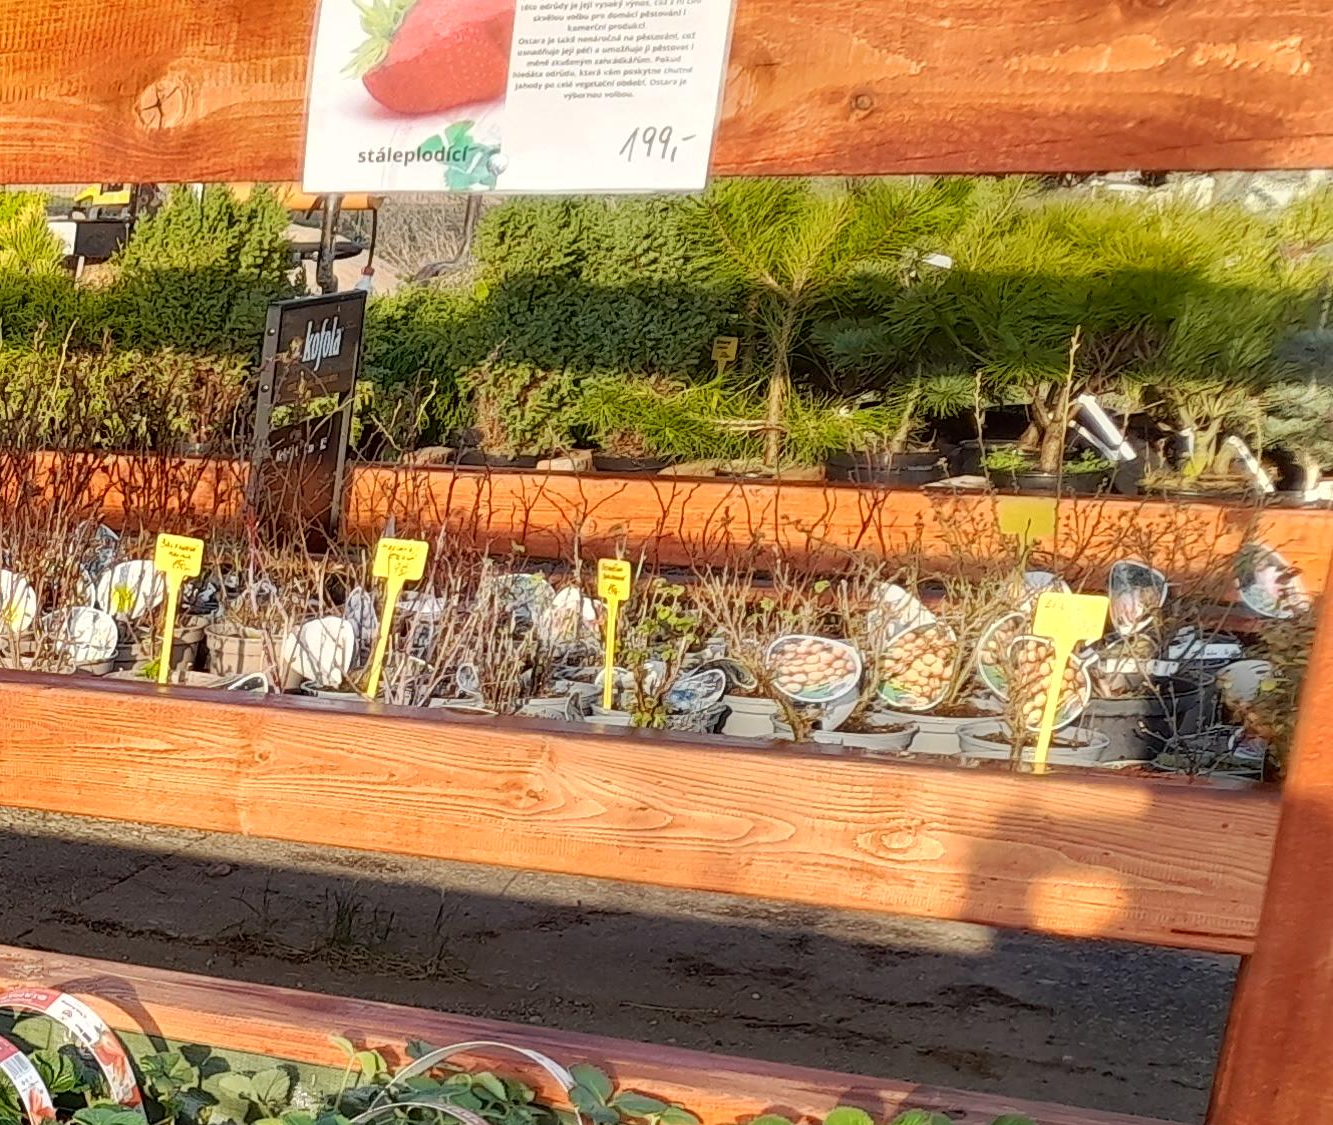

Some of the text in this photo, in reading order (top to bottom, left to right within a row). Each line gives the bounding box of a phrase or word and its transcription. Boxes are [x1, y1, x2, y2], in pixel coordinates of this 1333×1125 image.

[358, 146, 467, 167] stáleplodící
[619, 126, 696, 162] 199,-
[301, 316, 344, 372] kofola
